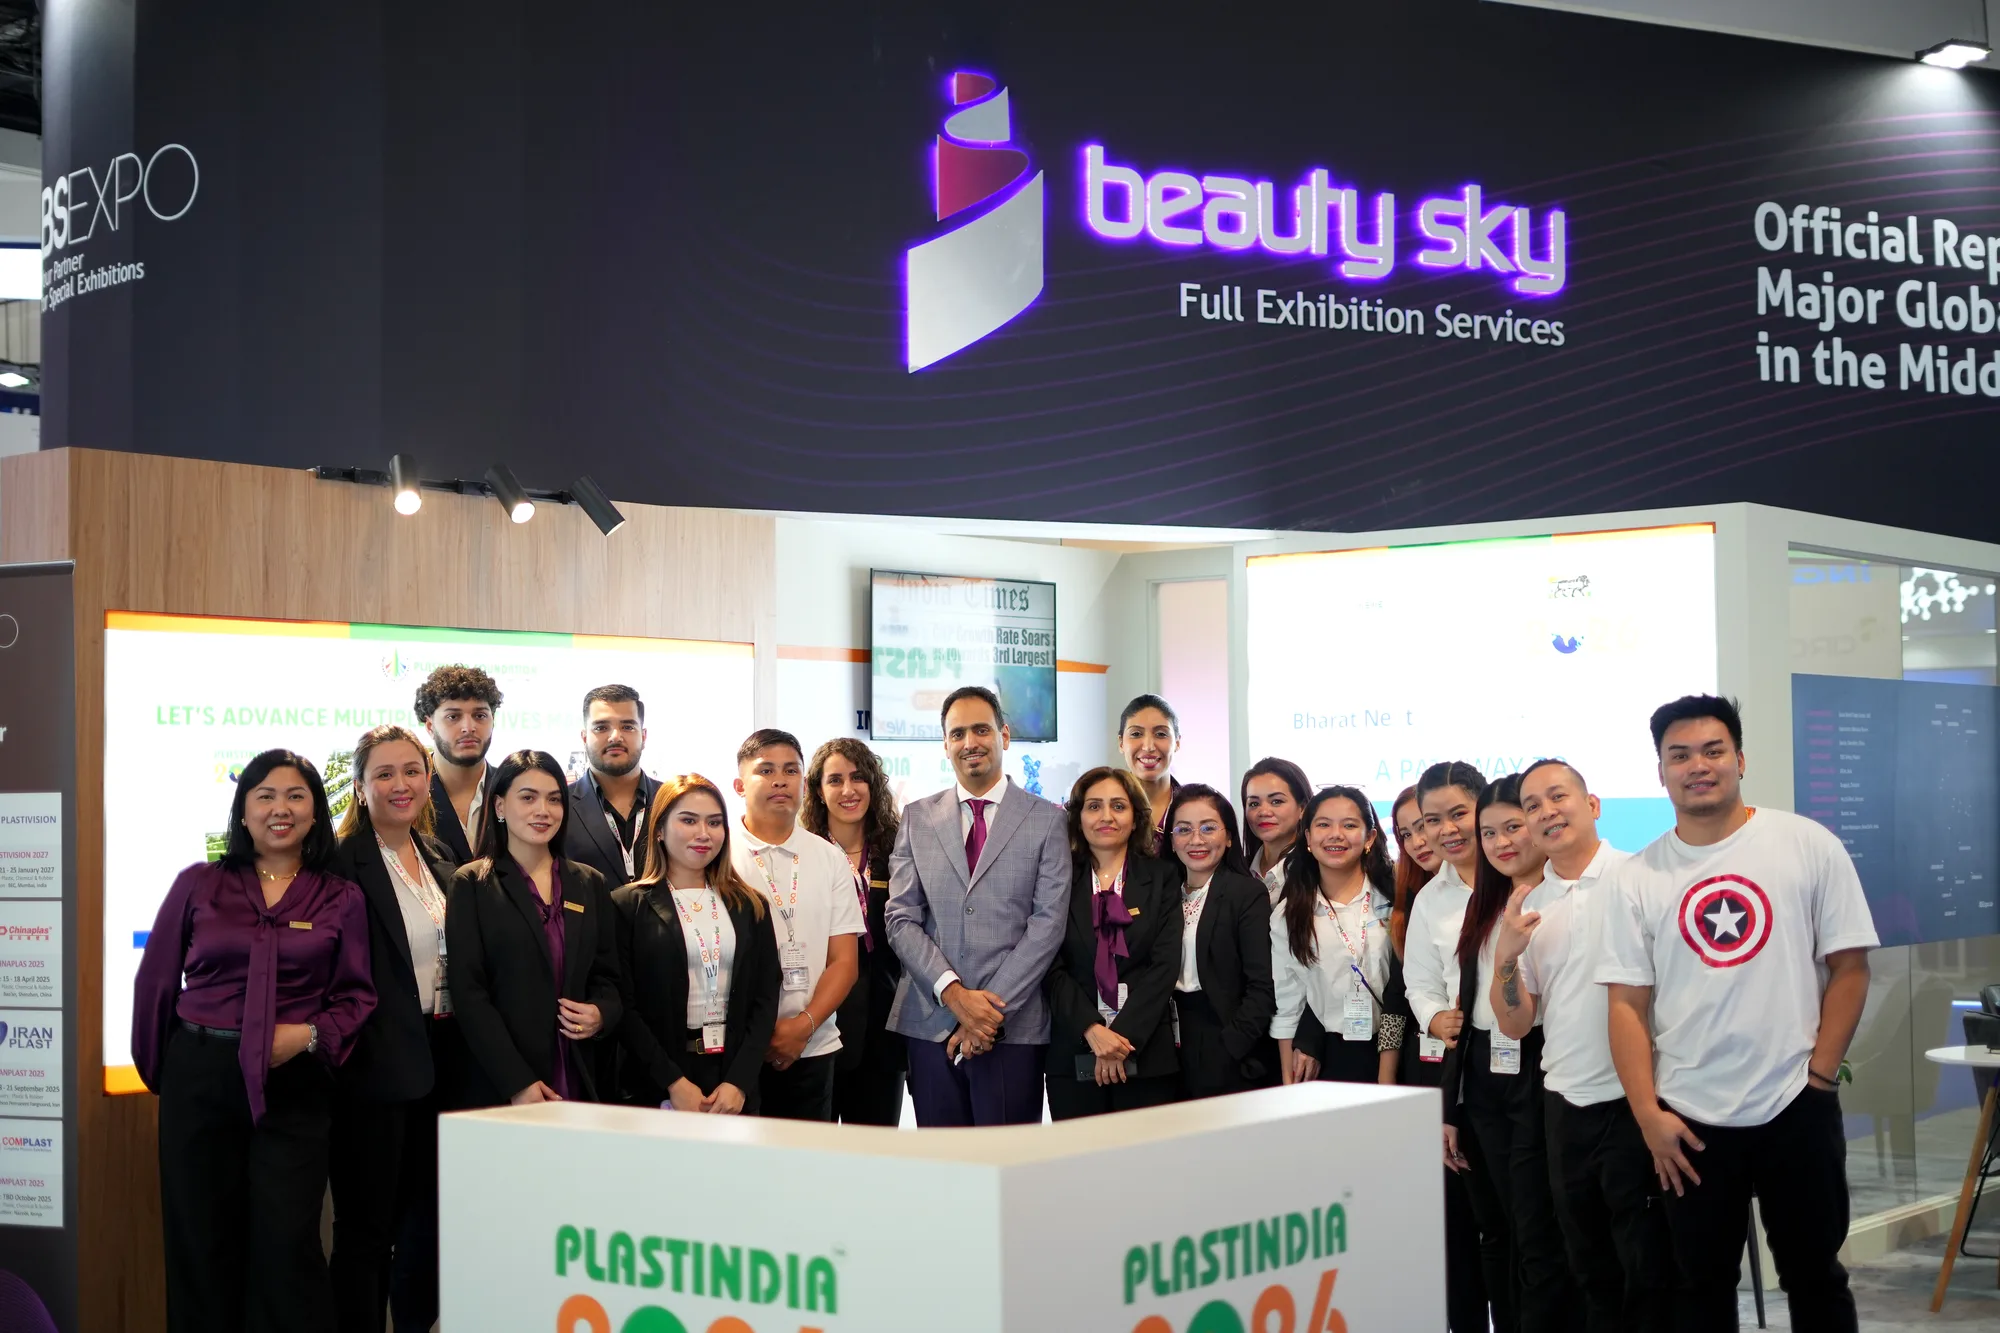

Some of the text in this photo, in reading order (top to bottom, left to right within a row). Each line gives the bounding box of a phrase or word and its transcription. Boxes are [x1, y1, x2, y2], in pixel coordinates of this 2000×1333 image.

[1088, 145, 1566, 293] beauty sky
[1754, 201, 1924, 265] Official
[53, 253, 85, 283] Partner
[49, 275, 75, 312] Special
[77, 262, 145, 295] Exhibitions
[1757, 266, 2000, 334] Major Glob
[1180, 282, 1566, 346] Full Exhibition Services
[1756, 331, 2000, 398] in the Midd
[996, 628, 1019, 646] Rate
[1021, 629, 1051, 647] Soars
[993, 647, 1010, 664] 3rd
[1012, 648, 1050, 667] Largest
[156, 705, 216, 726] LET'S
[222, 706, 327, 727] ADVANCE
[1293, 709, 1413, 729] Bharat Net
[1375, 759, 1391, 781] A
[1, 816, 56, 824] PLASTIVISION
[9, 926, 49, 935] Chinaplas
[10, 1039, 52, 1049] PLAST
[13, 1027, 52, 1039] IRAN
[2, 1137, 52, 1147] COMPLAST
[1123, 1202, 1348, 1306] PLASTINDIA
[555, 1224, 838, 1316] PLASTINDIA
